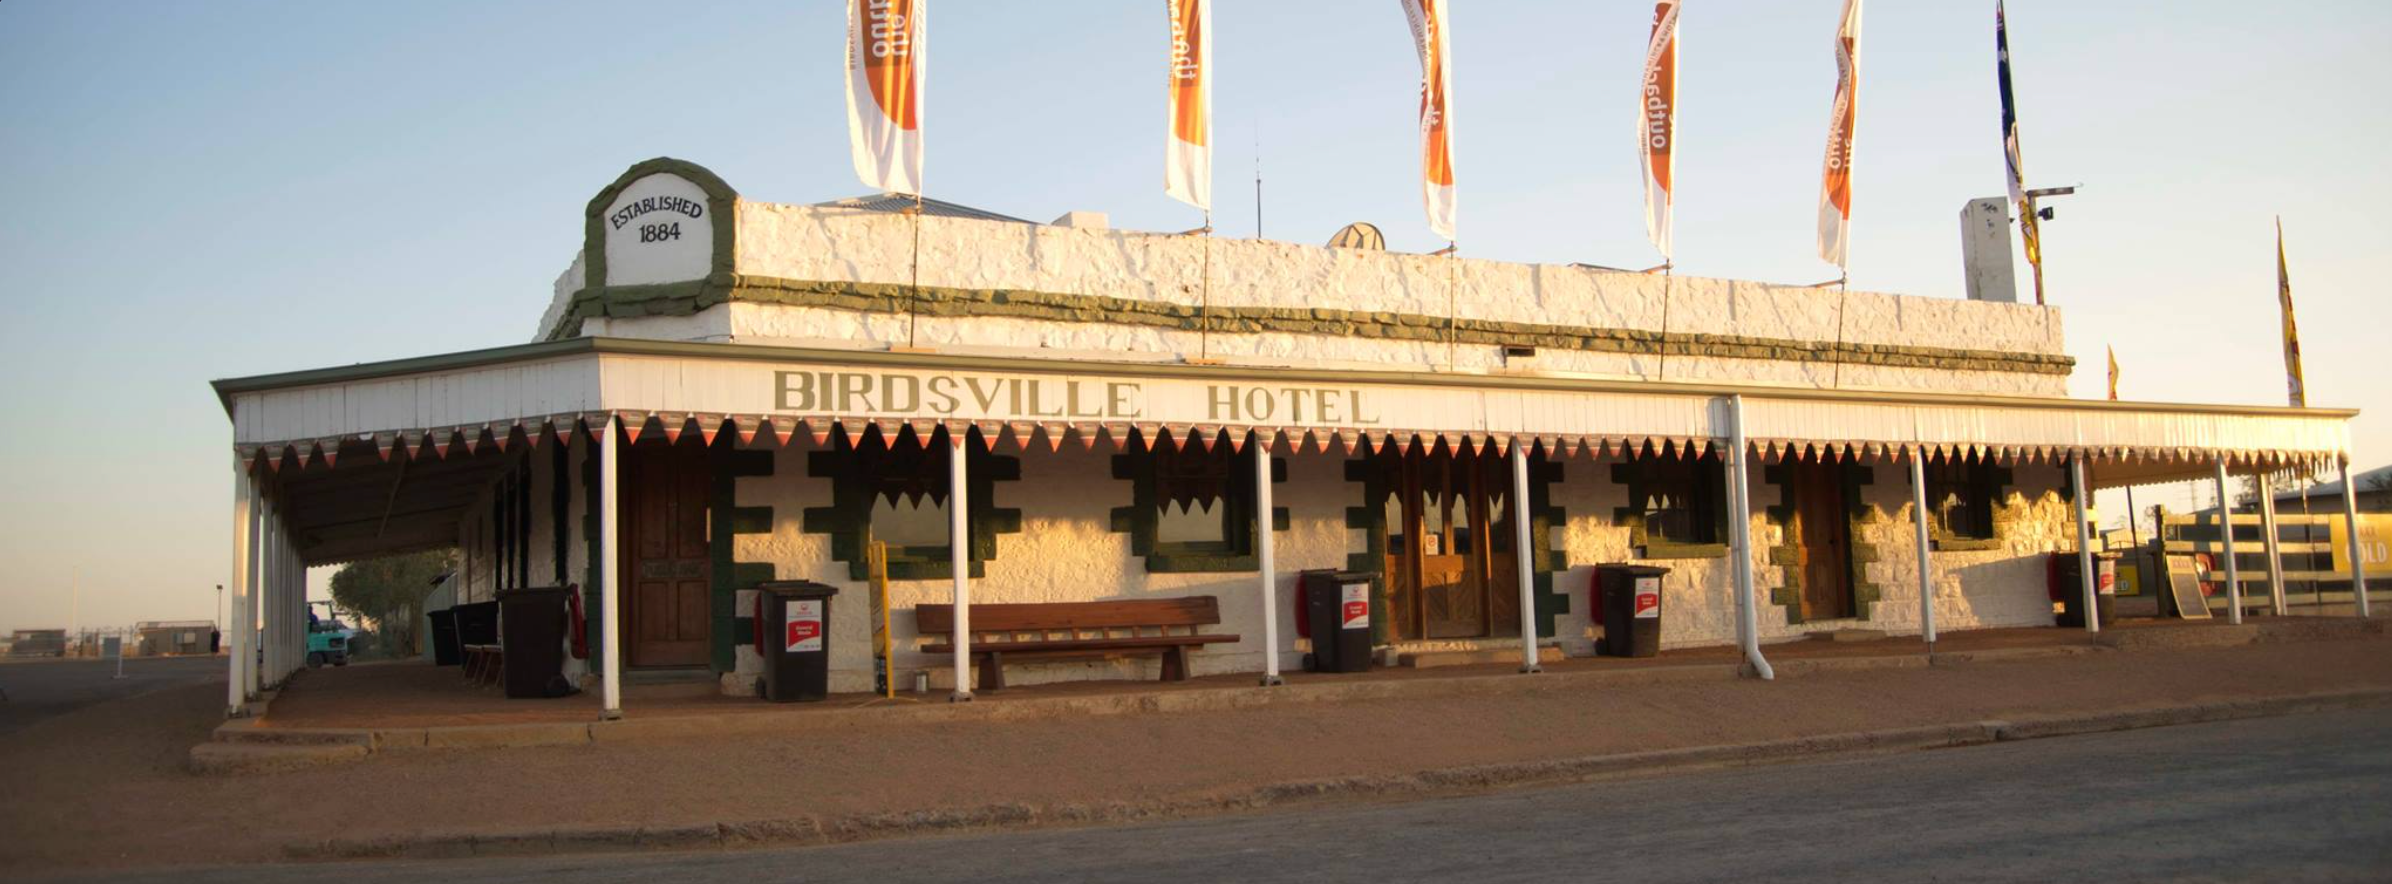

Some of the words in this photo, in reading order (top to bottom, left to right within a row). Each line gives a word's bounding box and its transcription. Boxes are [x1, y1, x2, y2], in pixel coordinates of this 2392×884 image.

[611, 195, 703, 230] ESTABLISHED
[639, 222, 681, 243] 1884
[774, 371, 1141, 418] BIRDSVILLE
[1207, 385, 1379, 423] HOTEL
